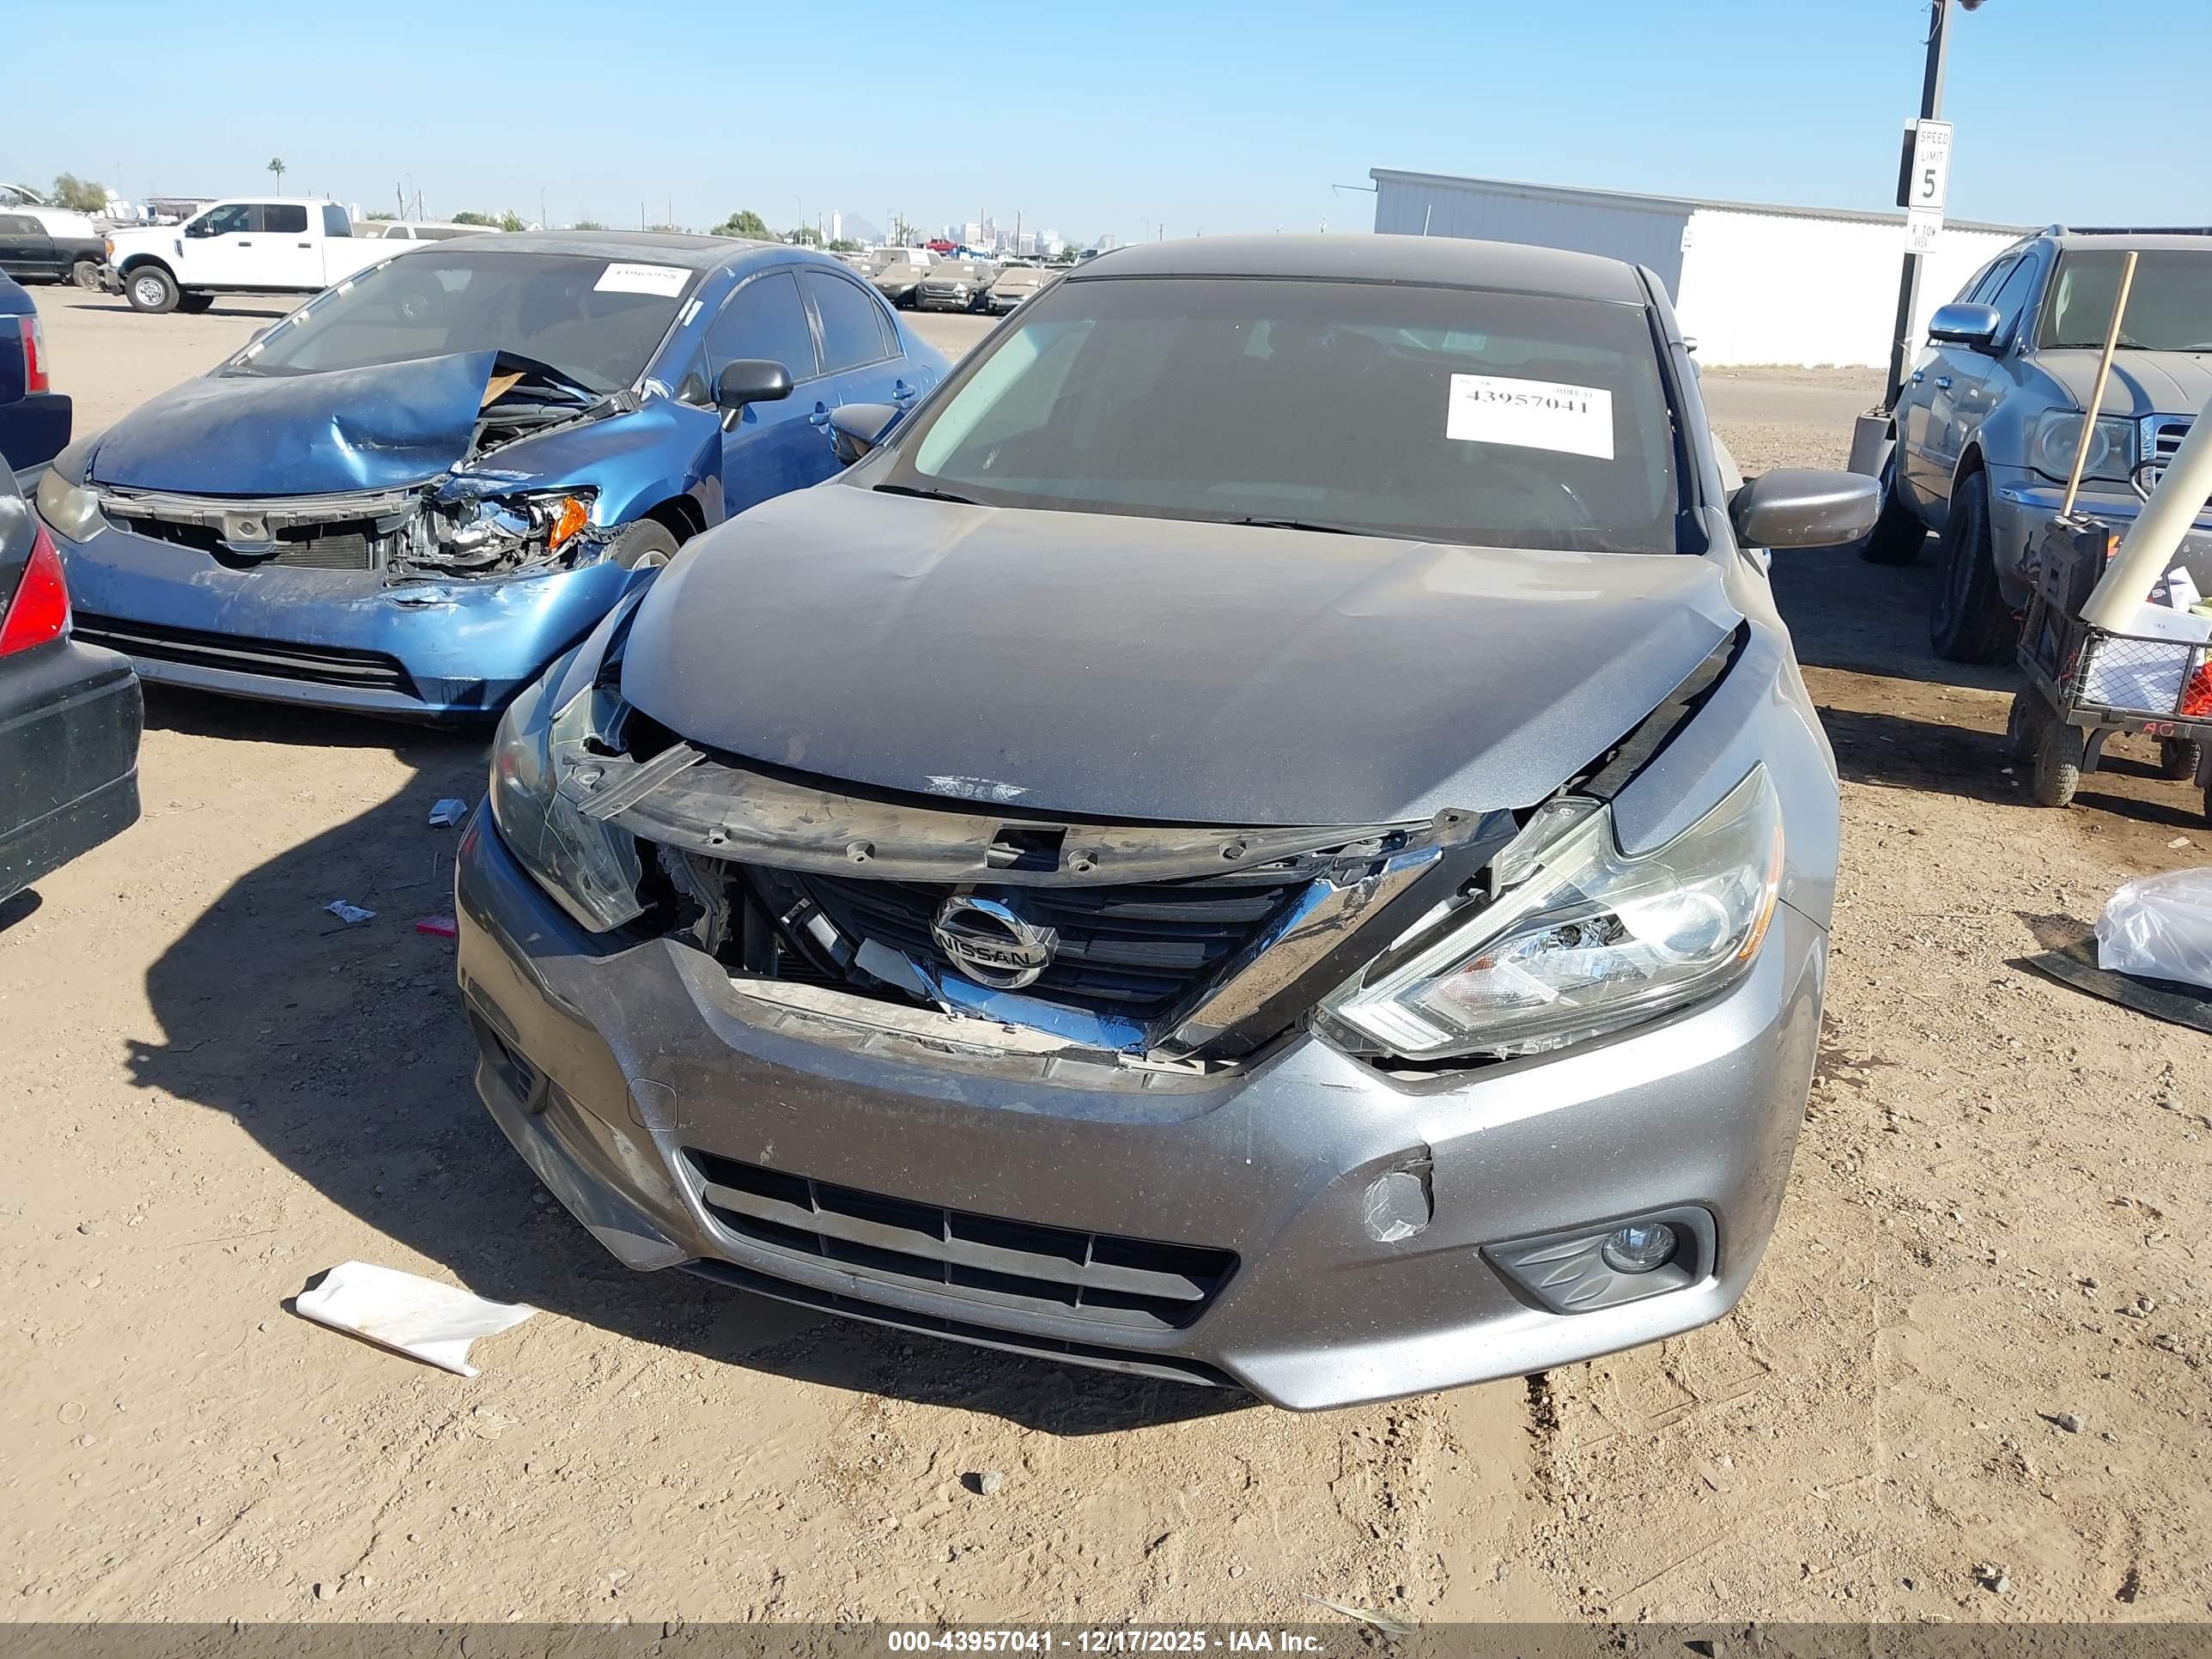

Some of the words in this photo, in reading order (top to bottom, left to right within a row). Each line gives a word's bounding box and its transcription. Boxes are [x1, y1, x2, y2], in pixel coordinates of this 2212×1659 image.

[1920, 131, 1948, 144] SPEED
[1921, 150, 1943, 162] LIMIT
[1922, 168, 1936, 198] 5
[1467, 390, 1588, 413] 43957041
[939, 933, 1030, 966] NISSAN
